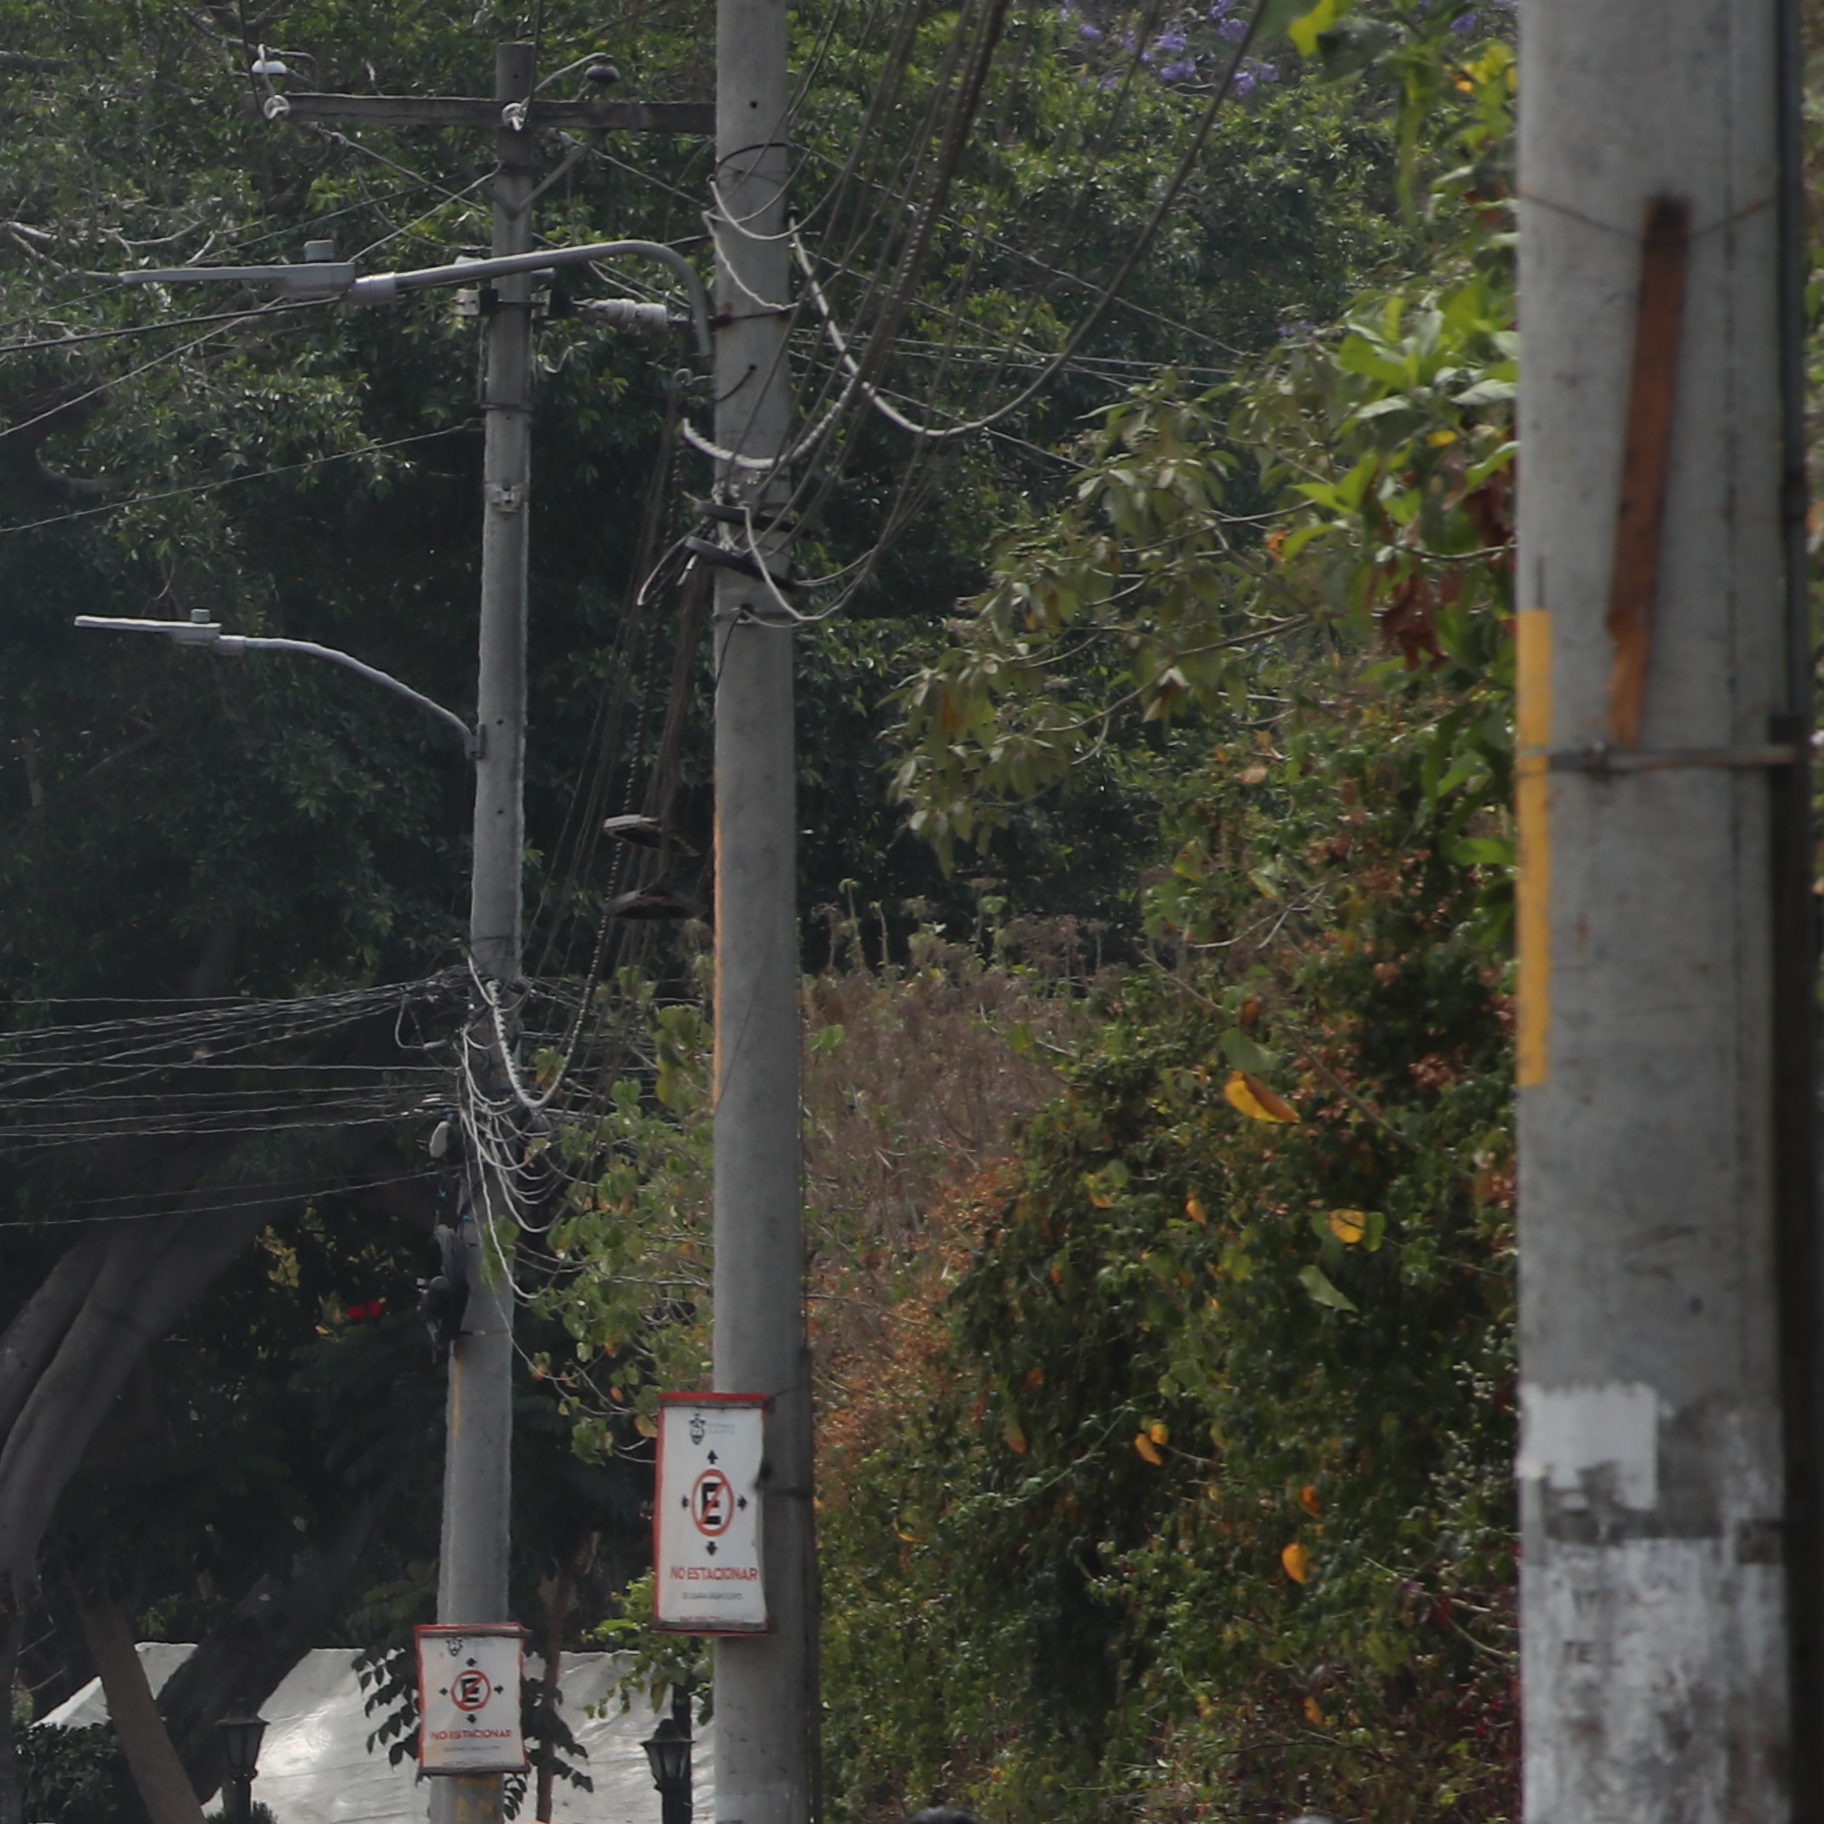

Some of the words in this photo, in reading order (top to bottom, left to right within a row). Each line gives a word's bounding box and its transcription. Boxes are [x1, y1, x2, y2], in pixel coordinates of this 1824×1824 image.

[670, 1566, 686, 1580] NO
[687, 1566, 759, 1581] ESTACIONAR
[431, 1731, 447, 1740] NO
[449, 1729, 512, 1740] ESTACIONAR
